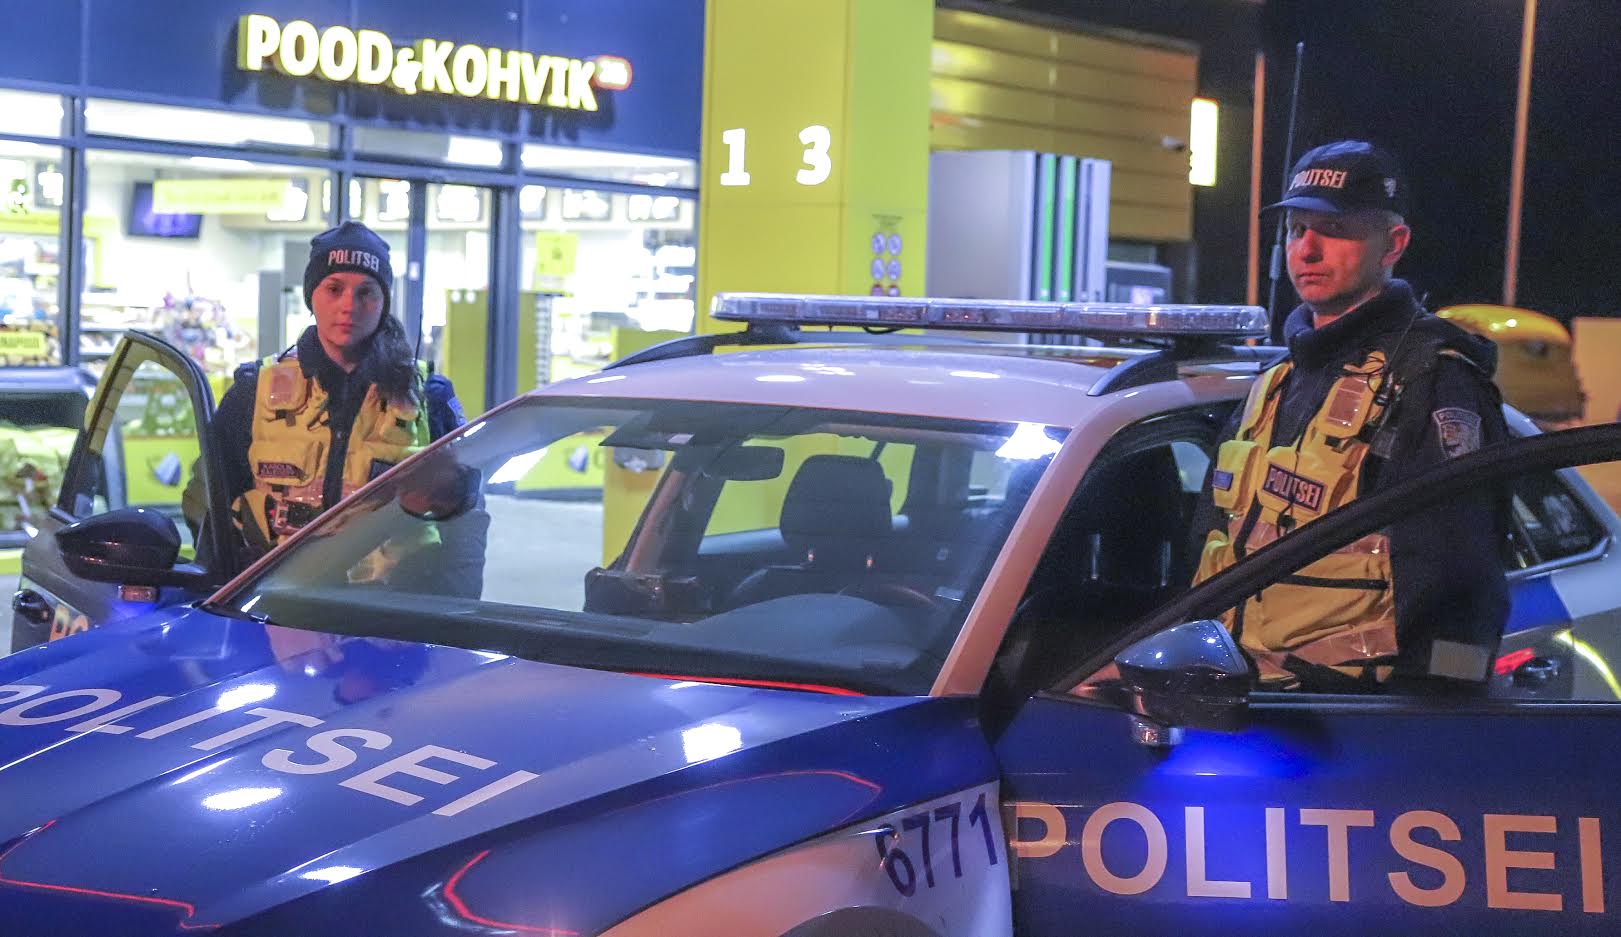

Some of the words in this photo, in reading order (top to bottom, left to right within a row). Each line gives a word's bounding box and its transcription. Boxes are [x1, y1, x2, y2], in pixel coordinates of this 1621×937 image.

[243, 14, 599, 110] POOD&KOHVIK
[720, 127, 751, 186] 1
[796, 124, 832, 186] 3
[328, 248, 380, 273] POLITSEI
[1265, 467, 1322, 508] POLITSEI
[875, 792, 998, 897] 6771
[1010, 801, 1605, 913] POLITSEI
